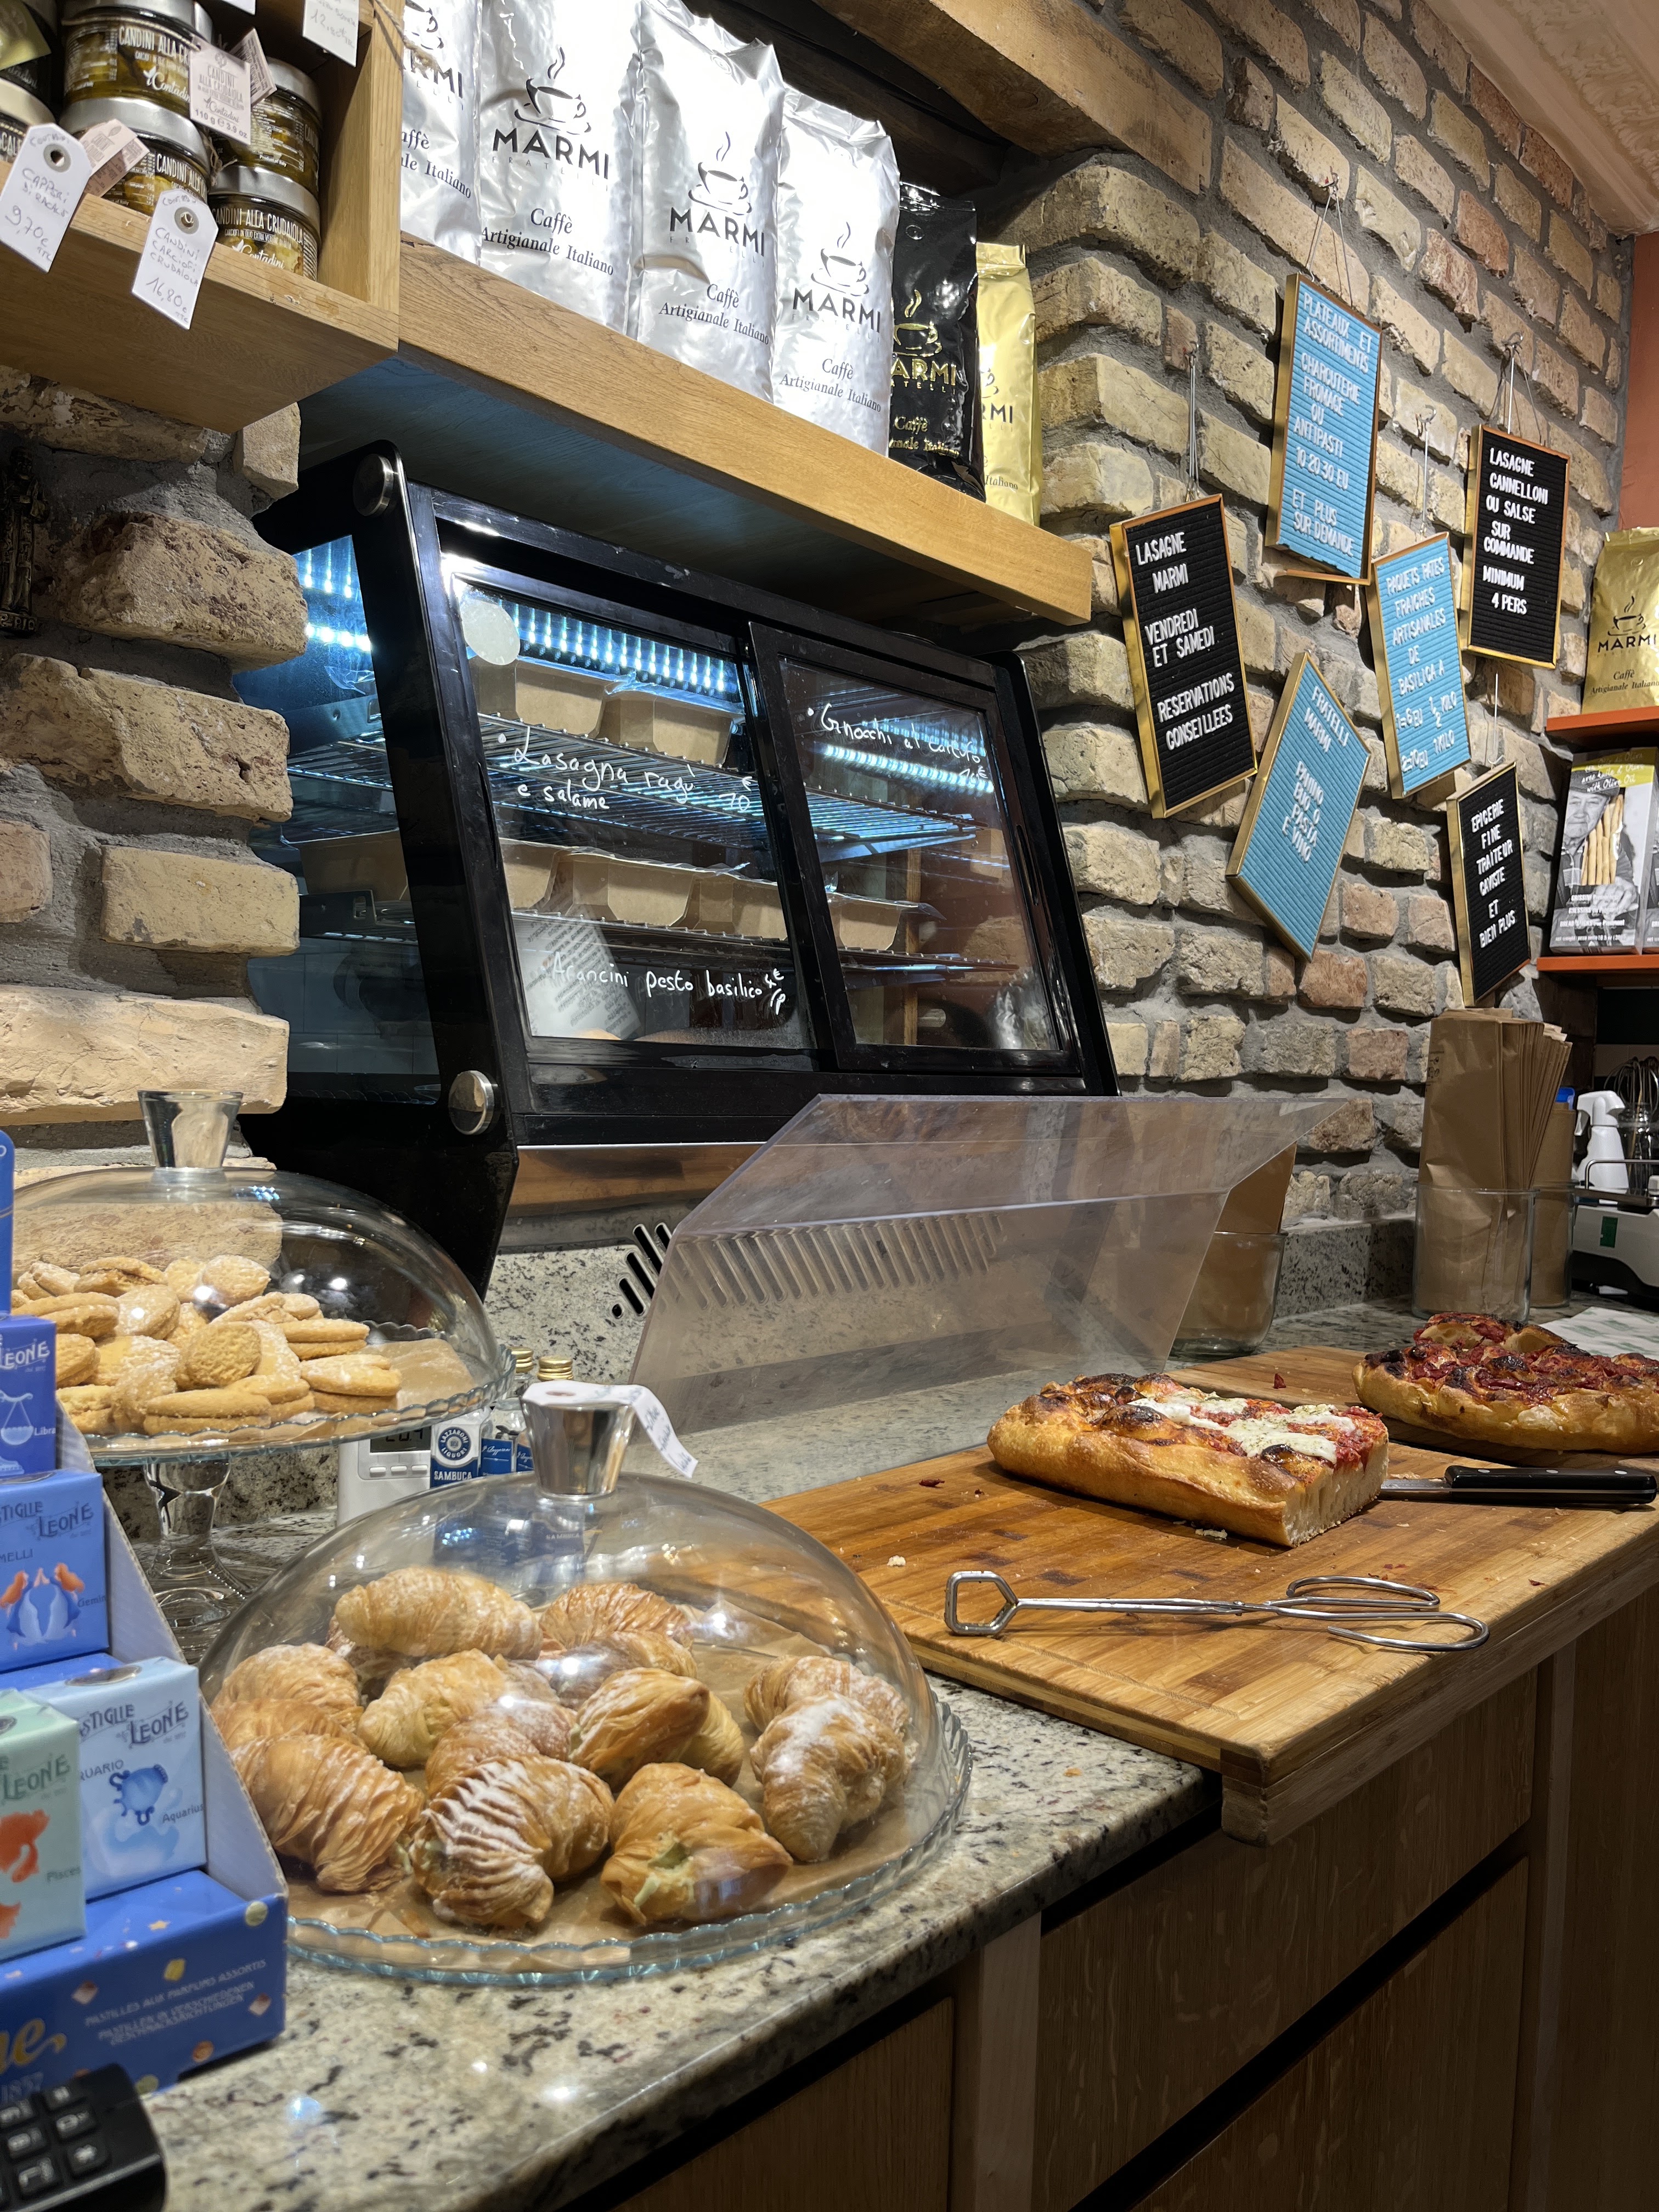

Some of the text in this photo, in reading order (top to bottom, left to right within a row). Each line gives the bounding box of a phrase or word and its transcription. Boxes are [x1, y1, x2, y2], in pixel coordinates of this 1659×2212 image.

[118, 26, 177, 59] CANDINI ALLA
[152, 71, 190, 101] Contadin
[207, 65, 235, 89] CANDINI
[195, 109, 208, 120] 110
[239, 130, 247, 138] oz
[401, 129, 430, 151] affè
[156, 153, 188, 183] CANDINI
[493, 127, 610, 180] MARMI
[425, 160, 472, 199] Italiano
[245, 209, 264, 229] ALLA
[267, 213, 303, 246] CRUDAIOLA
[530, 207, 573, 235] Caffè
[669, 206, 765, 258] MARMI
[481, 226, 614, 276] Artigianale Italiano
[706, 283, 740, 309] Caffè
[792, 287, 881, 335] MARMI
[658, 302, 770, 346] Artigianale Italiano
[1303, 291, 1373, 354] PLATEAUX ET
[1303, 316, 1370, 375] ASSORTIMENTS
[821, 358, 854, 381] Caffè
[890, 357, 957, 386] ARMI
[1301, 352, 1362, 407] CHARCUTERIE
[780, 373, 882, 413] Artigianale Italiano
[890, 381, 956, 395] ATELLI
[1303, 375, 1346, 417] FROMAGE
[894, 414, 928, 436] Caffè
[1311, 403, 1325, 426] OU
[1293, 416, 1344, 459] ANTIPASTI
[1296, 446, 1350, 490] 10 20 30 EU
[1489, 447, 1535, 477] LASAGNE
[984, 474, 1019, 491] Italiano
[1489, 472, 1549, 505] CANNELLONI
[1291, 488, 1338, 528] ET PLUS
[1486, 494, 1536, 525] OU SALSE
[1293, 511, 1356, 558] SUR DEMANDE
[1491, 520, 1511, 540] SUR
[1135, 531, 1187, 567] LASAGNE
[1483, 535, 1535, 565] COMMANDE
[1152, 562, 1189, 595] MARMI
[1385, 556, 1446, 596] PAQUETS PATES
[1482, 565, 1525, 592] MINIMUM
[1394, 585, 1436, 619] FRAICHES
[1491, 591, 1527, 616] 4 PERS
[1144, 607, 1200, 646] VENDREDI
[1392, 607, 1447, 647] ARTISANALES
[1597, 633, 1657, 653] MARMI
[1152, 625, 1216, 669] ET SAMEDI
[1407, 644, 1421, 666] DE
[1590, 682, 1629, 696] Artigianale
[1613, 669, 1635, 681] Caffè
[1156, 672, 1235, 724] RESERVATIONS
[820, 702, 893, 745] Gnocchi
[1165, 703, 1233, 751] CONSEILLEES
[1304, 707, 1332, 753] MARMI
[1312, 686, 1350, 747] FRATELLI
[514, 725, 628, 792] Lasagna
[517, 778, 611, 810] e salame
[1295, 760, 1324, 806] PANINO
[1291, 803, 1318, 848] PASTA
[1471, 798, 1505, 833] EPICERIE
[1282, 816, 1312, 863] E VINO
[1481, 823, 1502, 850] FINE
[1476, 839, 1514, 876] TRAITEUR
[1479, 866, 1506, 898] CAVISTE
[1488, 899, 1500, 919] ET
[1479, 909, 1516, 949] BIEN PLUS
[552, 951, 629, 988] Arancini
[646, 969, 694, 998] pesto
[706, 969, 763, 999] basilico
[33, 1426, 57, 1436] Libra
[440, 1429, 469, 1444] LAZZARONI
[441, 1447, 469, 1459] LIQUORI
[433, 1470, 473, 1481] SAMBUCA
[0, 1500, 44, 1523] TIGLIE
[38, 1502, 94, 1538] LEONE
[0, 1548, 34, 1563] MELLI
[77, 1594, 106, 1608] Gemin
[80, 1703, 136, 1738] STIGLIE
[130, 1701, 189, 1745] LEONE
[3, 1754, 71, 1800] LEONE
[162, 1803, 205, 1824] Aquarius
